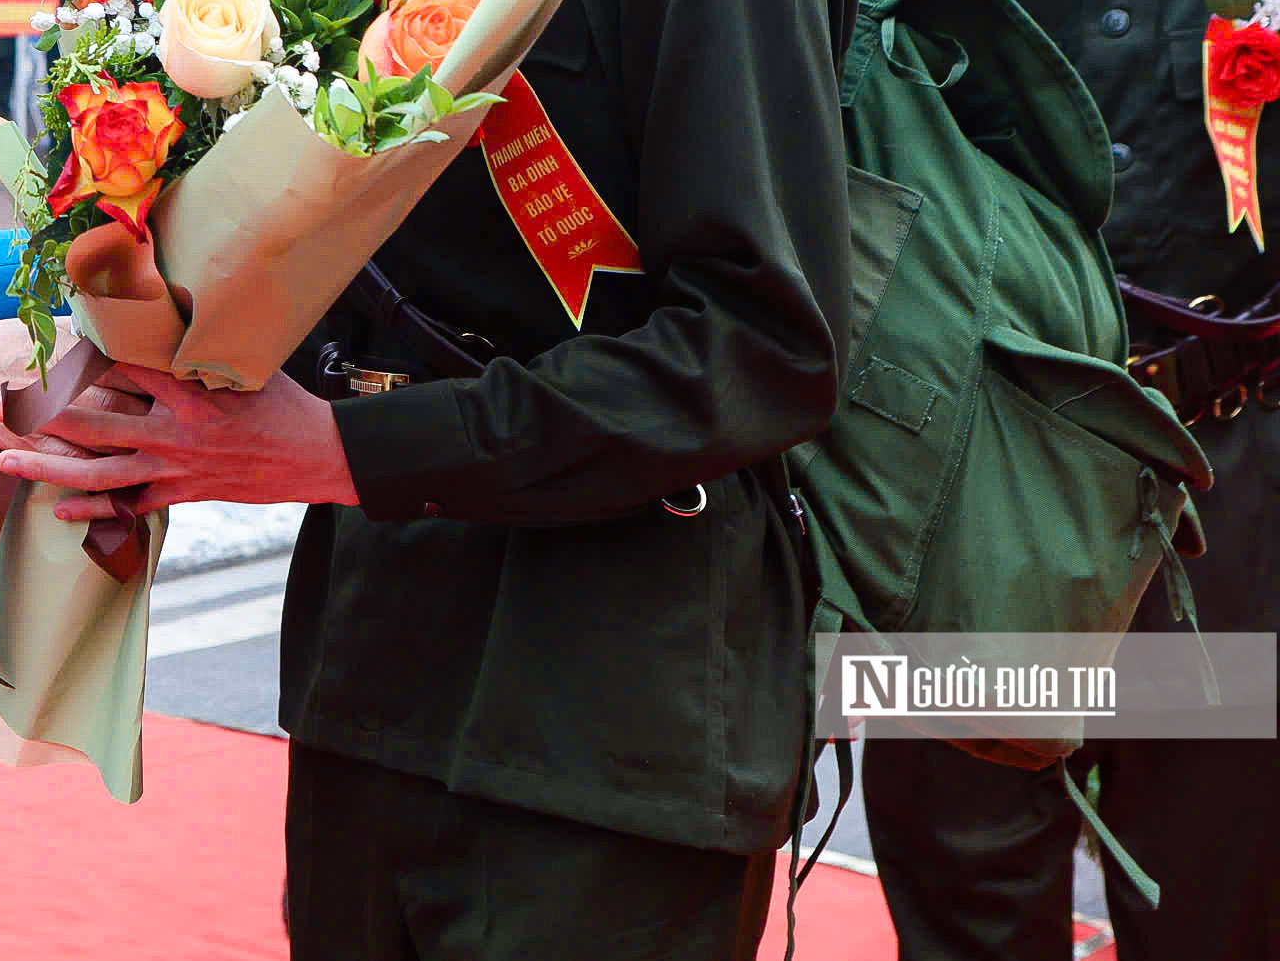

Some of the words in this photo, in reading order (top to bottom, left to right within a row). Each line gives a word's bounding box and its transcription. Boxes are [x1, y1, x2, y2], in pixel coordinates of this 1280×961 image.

[490, 138, 525, 168] THANH
[522, 124, 552, 150] NIÊN
[507, 173, 529, 193] BA
